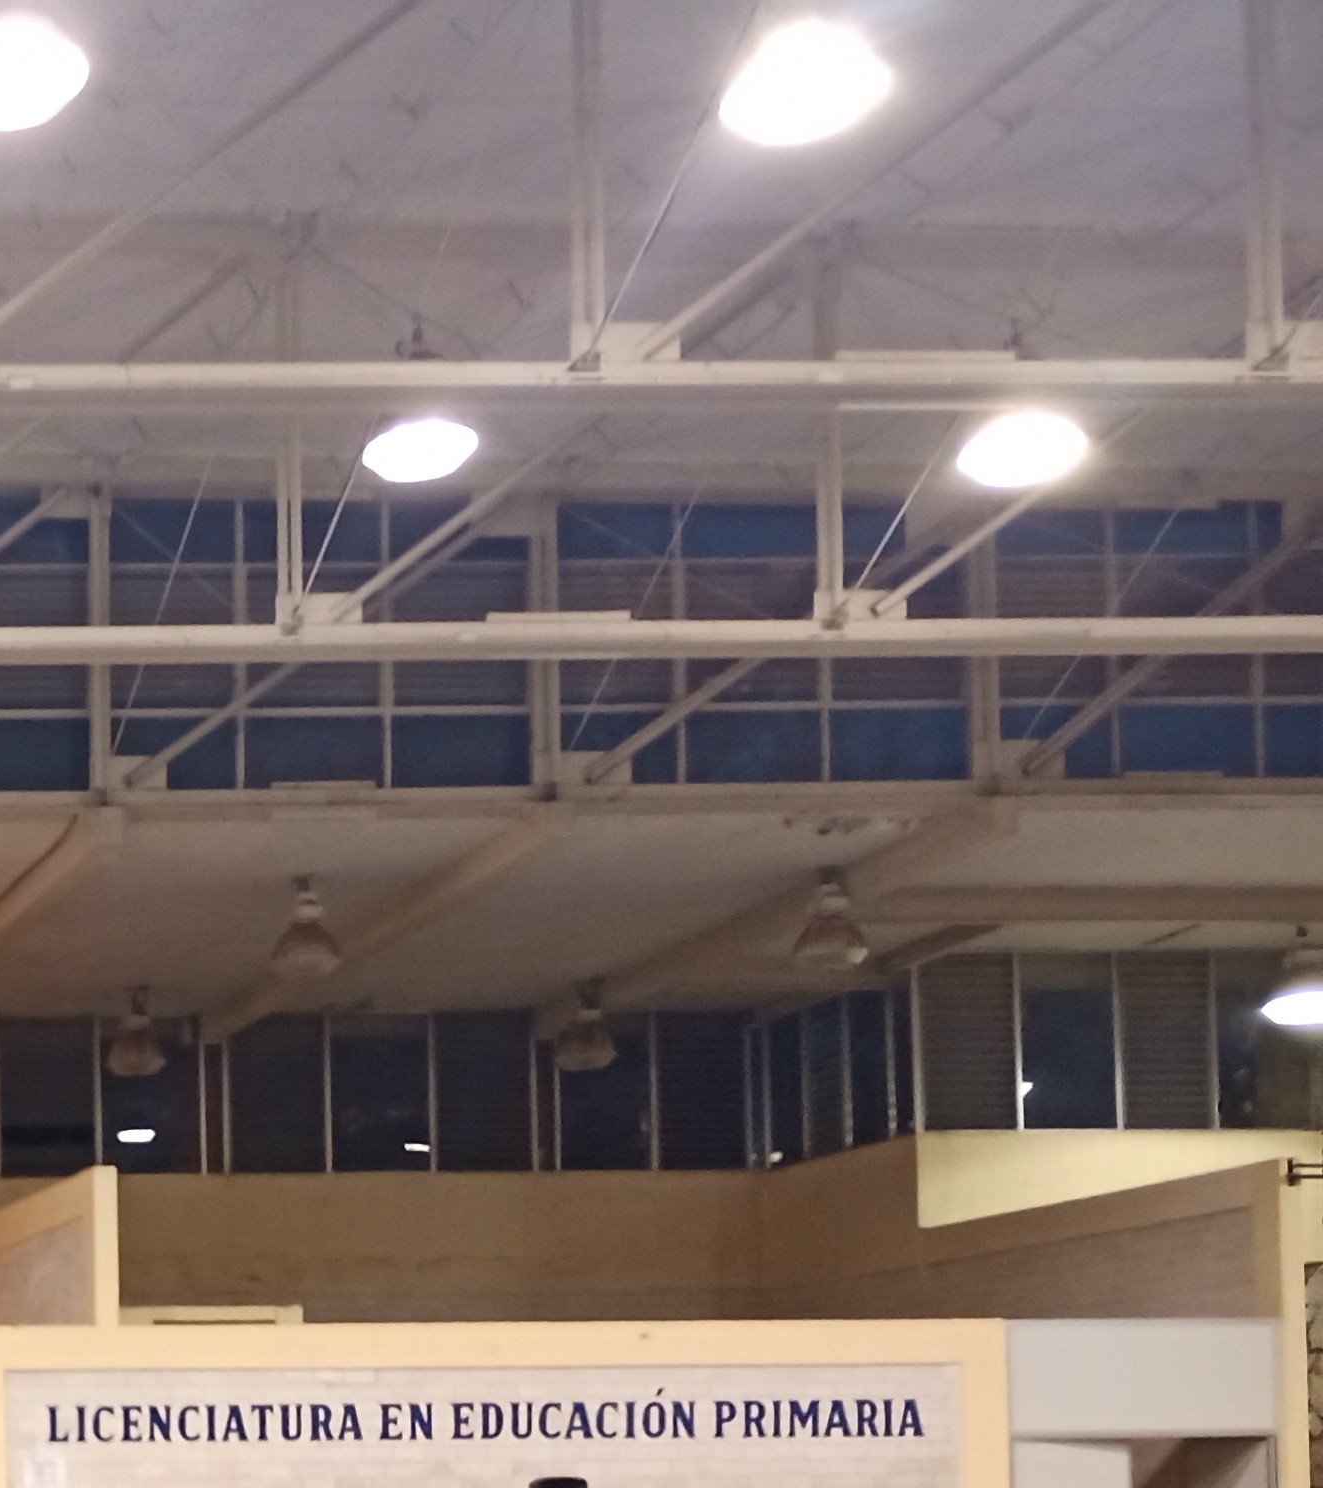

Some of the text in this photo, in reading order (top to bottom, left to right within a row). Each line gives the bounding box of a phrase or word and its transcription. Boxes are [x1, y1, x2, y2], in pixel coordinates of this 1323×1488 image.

[47, 1388, 926, 1443] LICENCIATURA EN EDUCACIÓN PRIMARIA
